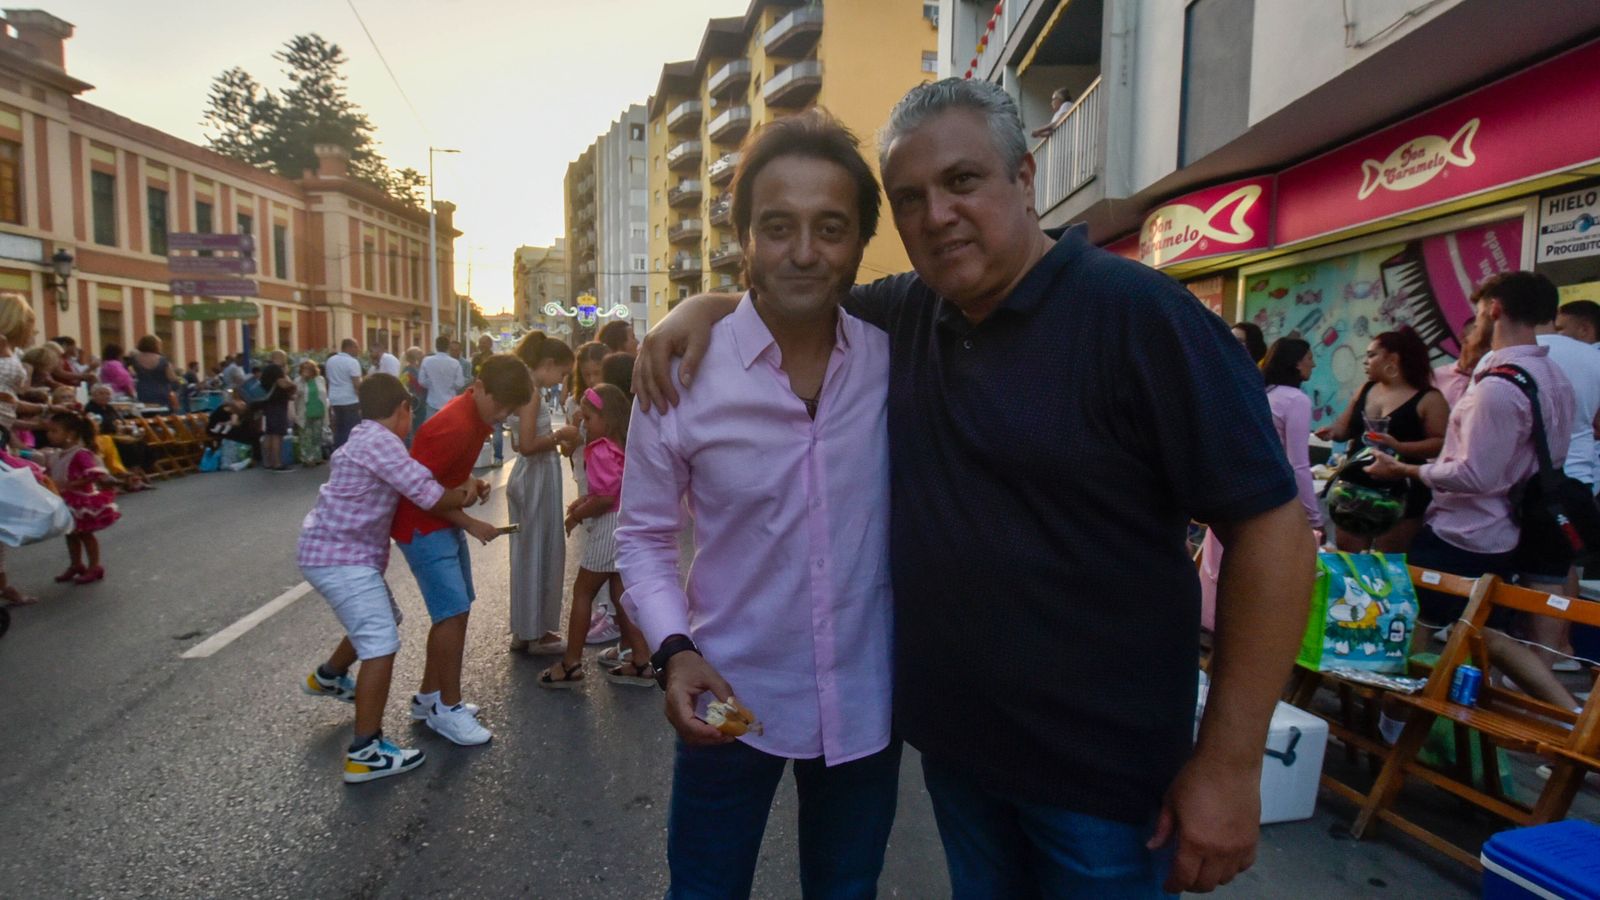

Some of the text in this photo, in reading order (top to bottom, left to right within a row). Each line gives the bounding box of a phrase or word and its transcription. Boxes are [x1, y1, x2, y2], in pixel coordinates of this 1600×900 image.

[1401, 144, 1425, 167] Don
[1384, 153, 1444, 184] Caramelo
[1550, 191, 1597, 216] HIELO
[1149, 215, 1172, 235] Don
[1140, 225, 1199, 259] Caramelo
